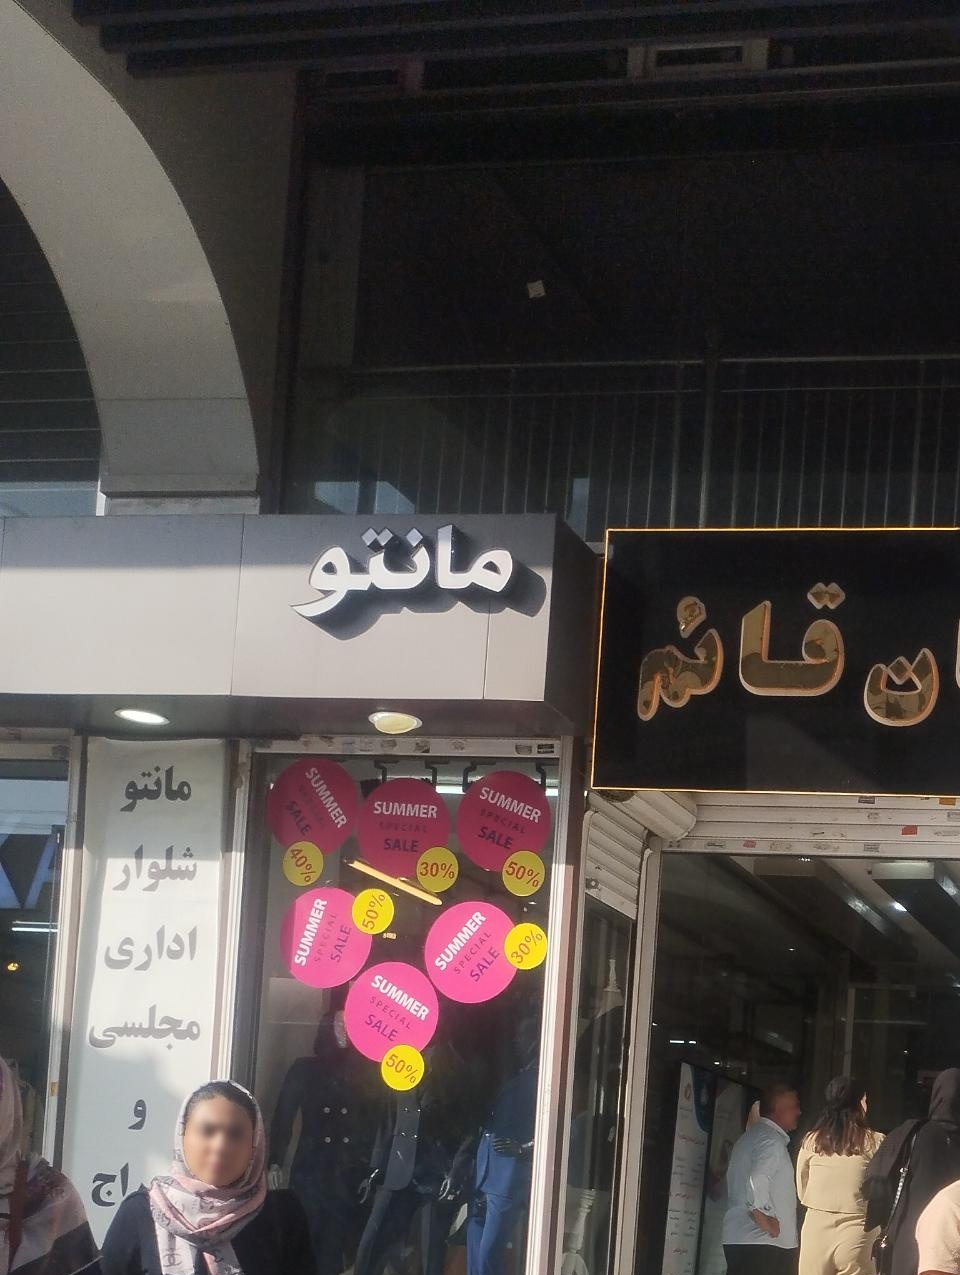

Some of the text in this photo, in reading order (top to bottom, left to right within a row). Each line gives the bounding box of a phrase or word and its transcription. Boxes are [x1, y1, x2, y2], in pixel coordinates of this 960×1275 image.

[290, 524, 514, 617] مانتو
[637, 581, 846, 722] قائم
[119, 765, 192, 812] مانتو
[304, 767, 348, 829] SUMMER
[479, 786, 542, 824] SUMMER
[286, 800, 312, 836] SALE
[373, 801, 438, 819] SUMMER
[384, 838, 419, 852] SALE
[478, 826, 514, 850] SALE
[112, 844, 198, 892] شلوار
[290, 848, 318, 884] 40%
[420, 861, 455, 879] 30%
[505, 860, 540, 889] 50%
[362, 893, 386, 930] 50%
[104, 925, 198, 971] اداری
[294, 898, 327, 967] SUMMER
[330, 926, 351, 963] SALE
[434, 911, 486, 971] SUMMER
[511, 930, 543, 965] 30%
[470, 946, 500, 983] SALE
[371, 975, 430, 1021] SUMMER
[88, 1004, 201, 1050] مجلسی
[364, 1014, 398, 1042] SALE
[385, 1054, 417, 1084] 50%
[128, 1099, 147, 1130] و
